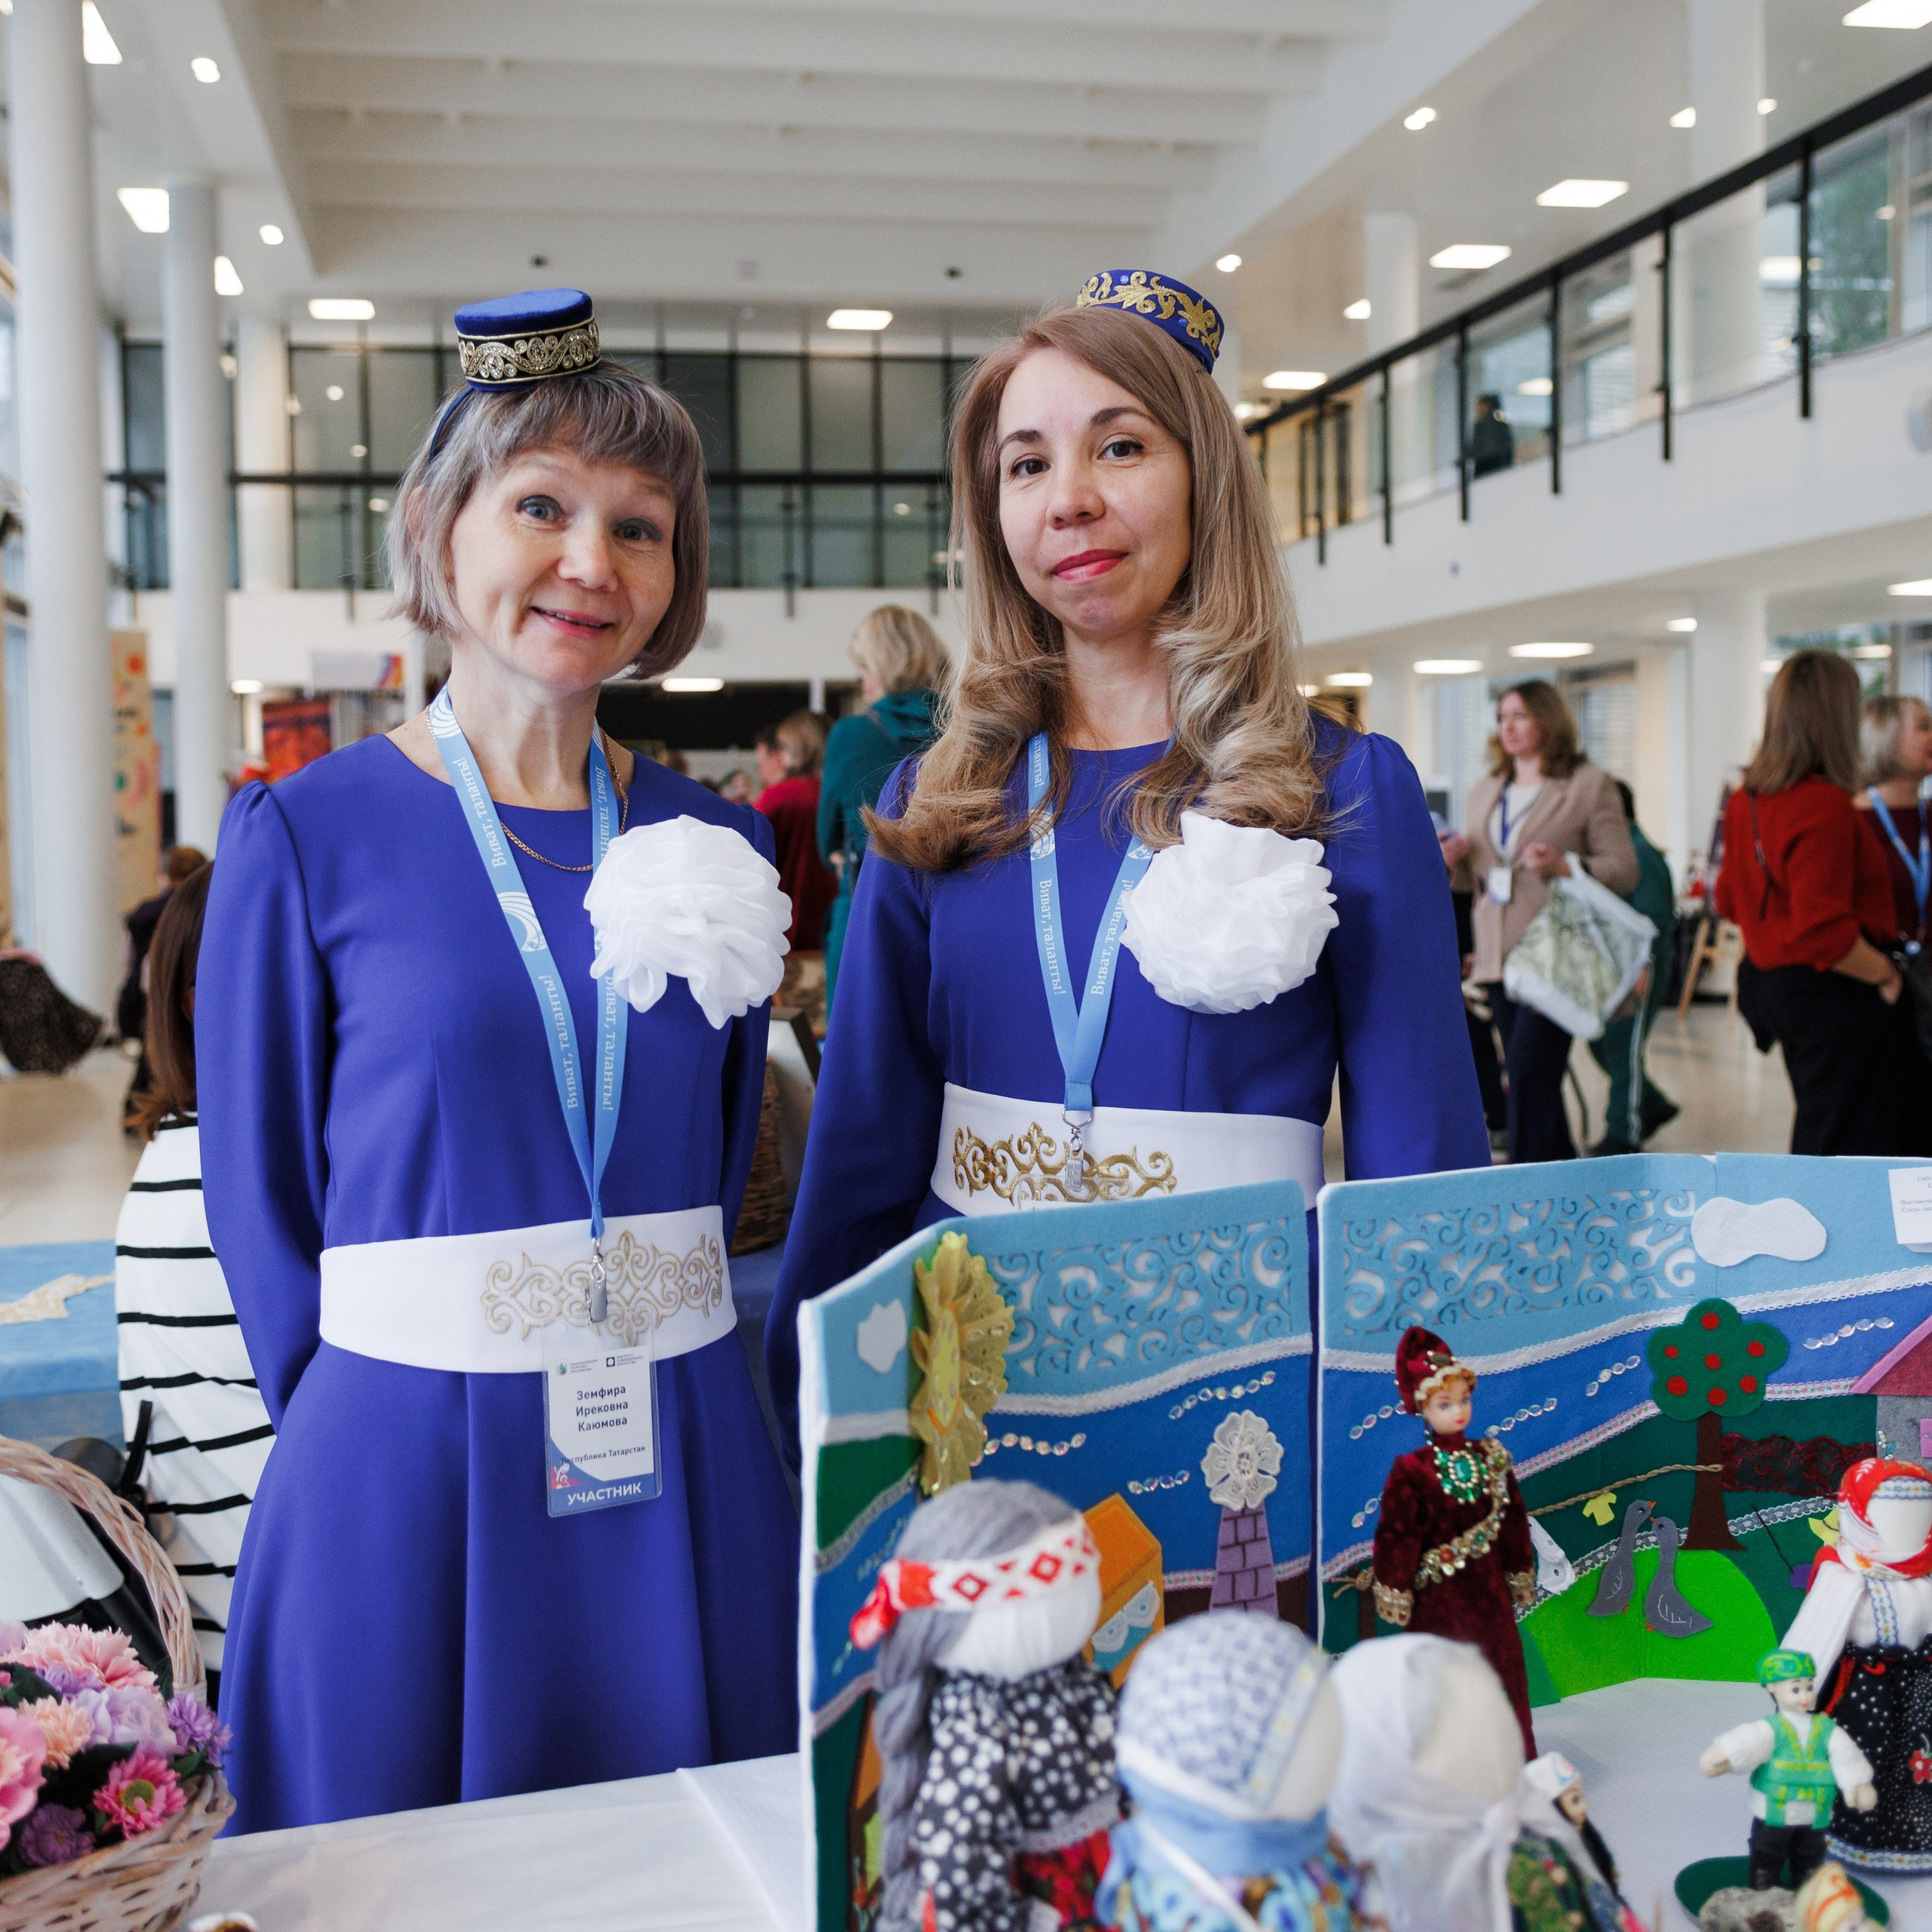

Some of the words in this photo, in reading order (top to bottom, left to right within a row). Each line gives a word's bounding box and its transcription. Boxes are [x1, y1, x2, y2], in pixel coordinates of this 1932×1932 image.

[453, 756, 488, 819] таланты!
[595, 765, 607, 804] Виват,
[481, 819, 507, 868] Виват,
[1039, 878, 1052, 924] Виват,
[1043, 925, 1066, 995] таланты!
[1091, 946, 1114, 995] Виват,
[1105, 879, 1134, 943] таланы!
[538, 975, 570, 1051] таланты!
[564, 1053, 578, 1109] Виват,
[602, 1032, 616, 1111] таланты!
[576, 1401, 629, 1417] Ирековна
[577, 1386, 626, 1400] Земфира
[578, 1417, 627, 1432] Каюмова
[561, 1452, 606, 1466] Республика
[608, 1446, 645, 1457] Татарстан
[568, 1481, 641, 1505] УЧАСТНИК
